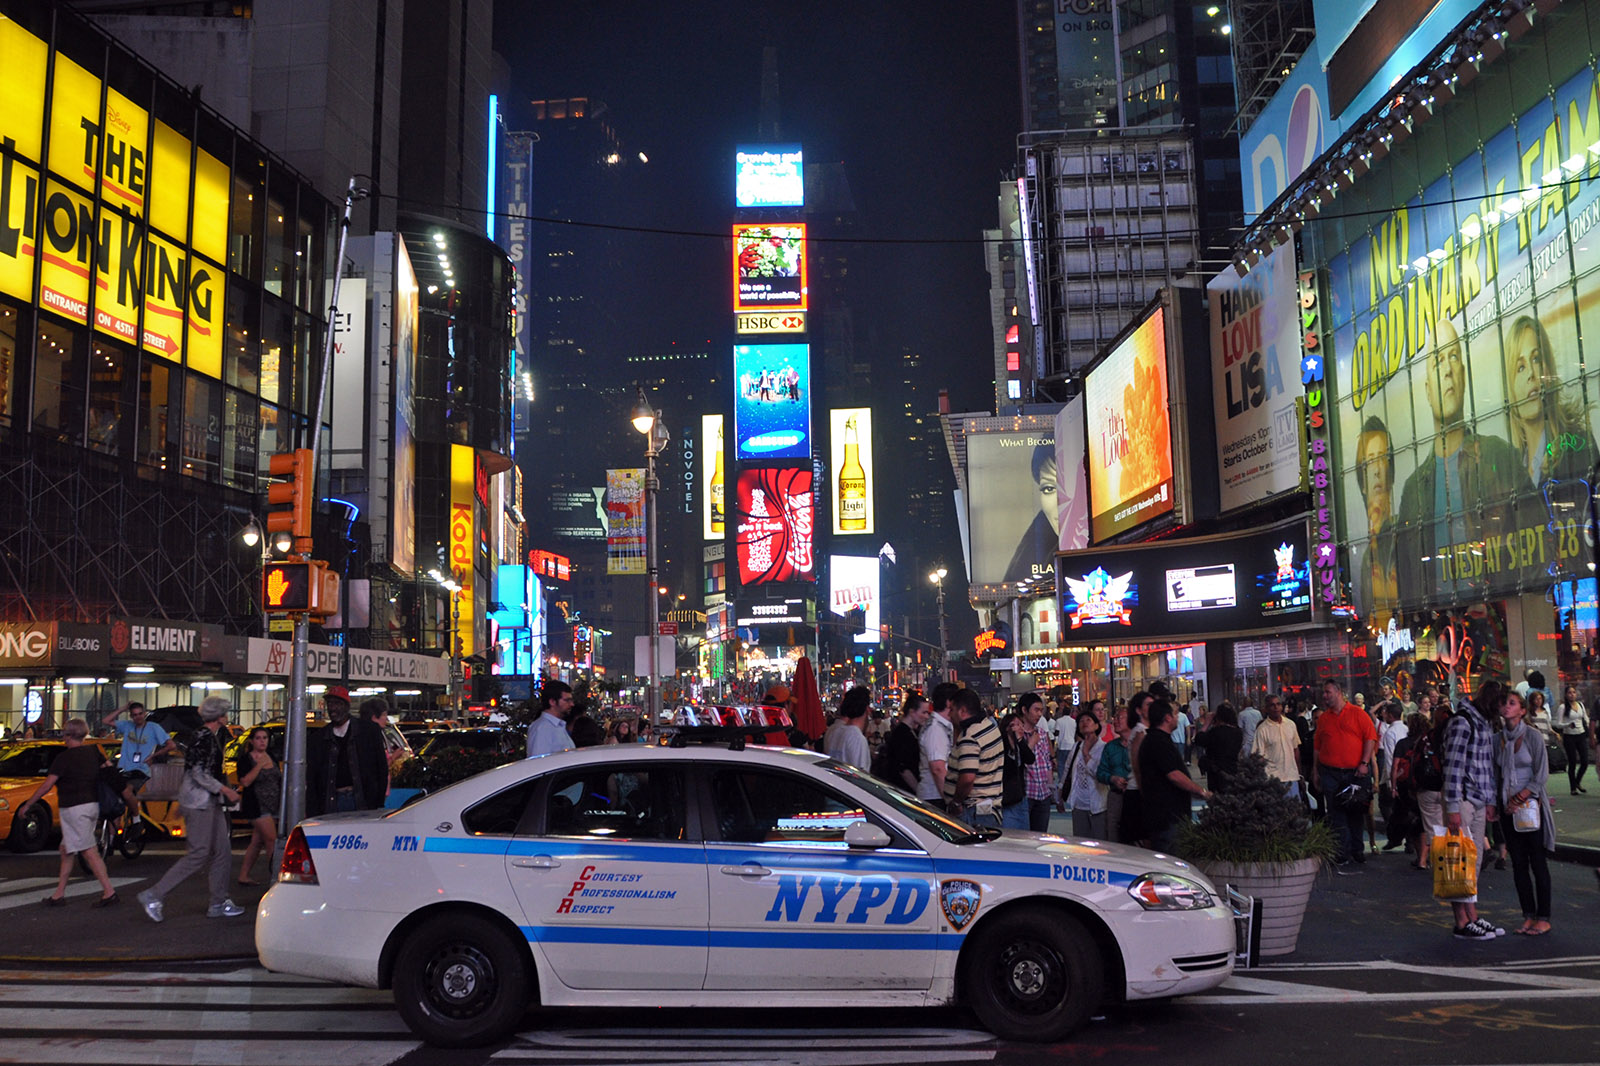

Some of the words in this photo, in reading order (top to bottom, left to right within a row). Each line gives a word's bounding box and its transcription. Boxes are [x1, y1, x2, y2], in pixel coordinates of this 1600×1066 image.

[80, 116, 145, 196] THE
[0, 135, 112, 276] LION
[508, 163, 527, 262] TIMES
[117, 203, 213, 324] KING
[1370, 205, 1410, 312] NO
[44, 291, 88, 317] ENTRANCE
[1220, 259, 1277, 328] HARRY
[1352, 176, 1506, 411] ORDINARY
[98, 312, 112, 328] ON
[114, 318, 135, 337] 45TH
[738, 317, 780, 330] HSBC
[1221, 300, 1278, 370] LOVES
[143, 331, 167, 350] STREET
[1224, 343, 1285, 420] LISA
[1276, 410, 1293, 435] TV
[1101, 418, 1130, 469] Look
[1222, 433, 1256, 455] Wednesdays
[1223, 452, 1242, 468] Starts
[1242, 442, 1268, 460] October
[1268, 438, 1274, 449] 6
[683, 439, 693, 513] NOVOTEL
[452, 502, 472, 602] Kodak
[1438, 541, 1502, 583] TUESDAY
[1508, 524, 1545, 570] SEPT
[1556, 517, 1580, 559] 28
[1171, 580, 1186, 600] E
[0, 630, 48, 657] NG
[59, 636, 100, 652] BILLABONG
[131, 625, 196, 653] ELEMENT
[307, 649, 373, 676] OPENING
[376, 656, 406, 678] FALL
[409, 659, 429, 680] 2010
[1021, 656, 1052, 670] swatch
[391, 835, 419, 851] MTN
[580, 865, 643, 883] COURTESY
[1052, 863, 1106, 884] POLICE
[568, 881, 677, 899] PROFESSIONALISM
[765, 874, 930, 925] NYPD
[556, 898, 615, 914] RESPECT
